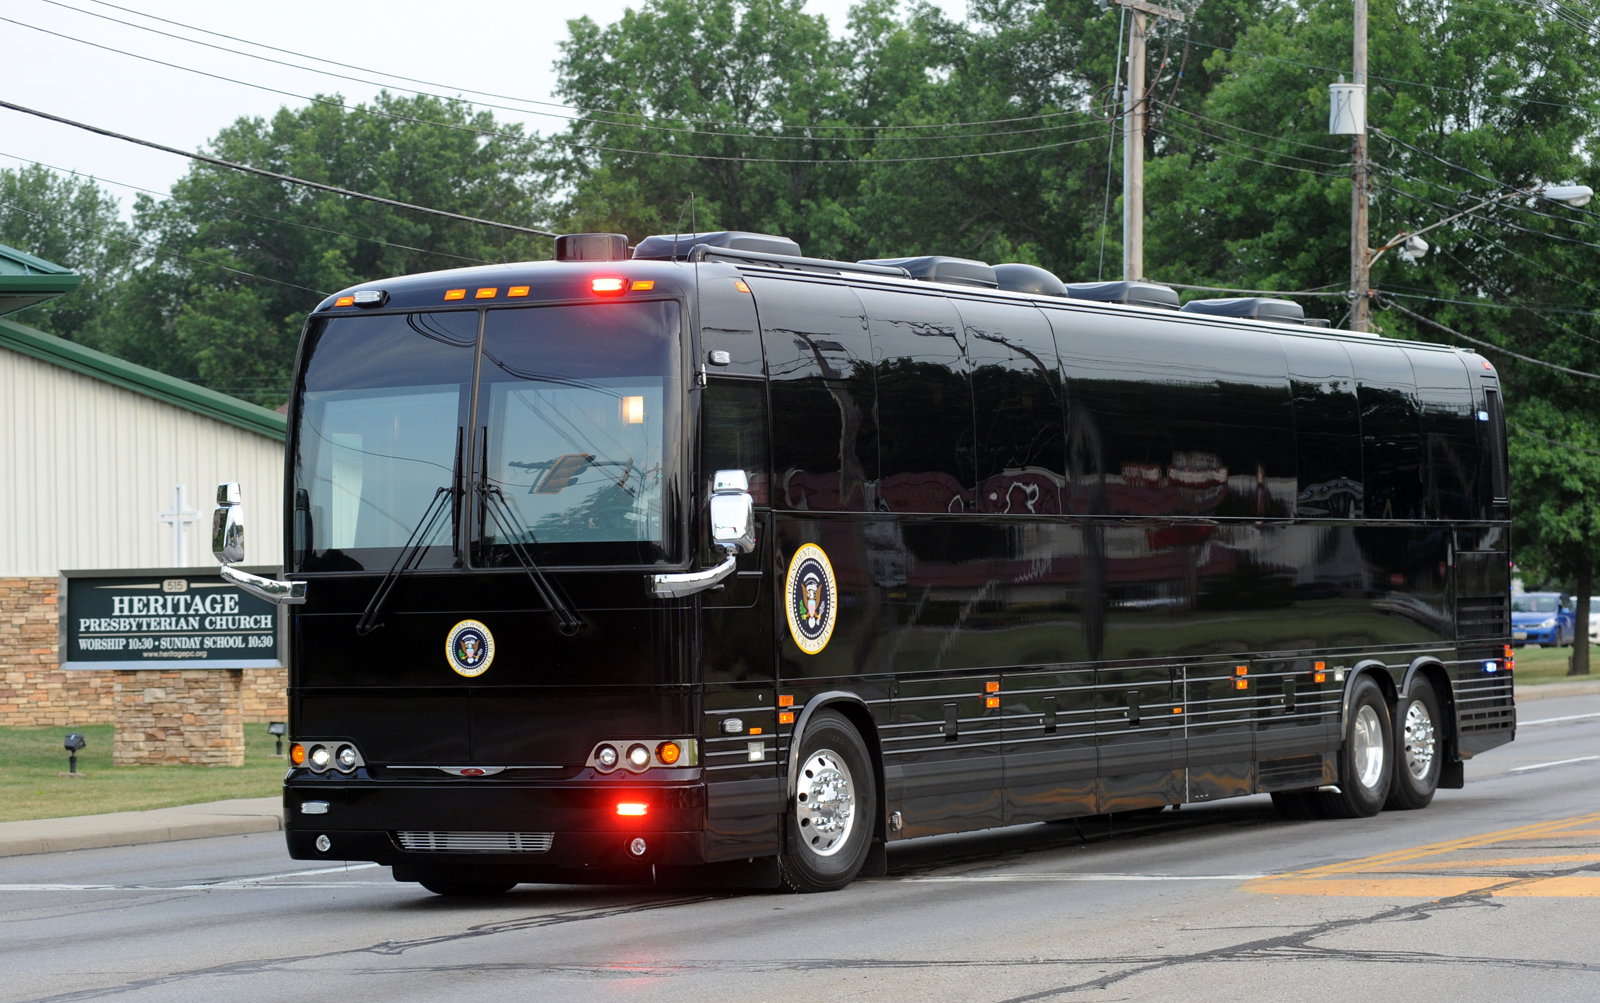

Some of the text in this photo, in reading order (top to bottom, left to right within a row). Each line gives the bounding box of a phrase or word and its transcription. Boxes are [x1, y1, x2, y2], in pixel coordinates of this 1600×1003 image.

[788, 548, 809, 596] PRESIDENT
[167, 581, 183, 590] 515
[112, 594, 239, 616] HERITAGE
[79, 614, 273, 632] PRESBYTERIAN CHURCH
[79, 635, 273, 651] WORSHIP 10:30 SUNDAY SCHOOL 10:30
[142, 650, 208, 659] www.heritagepc.org
